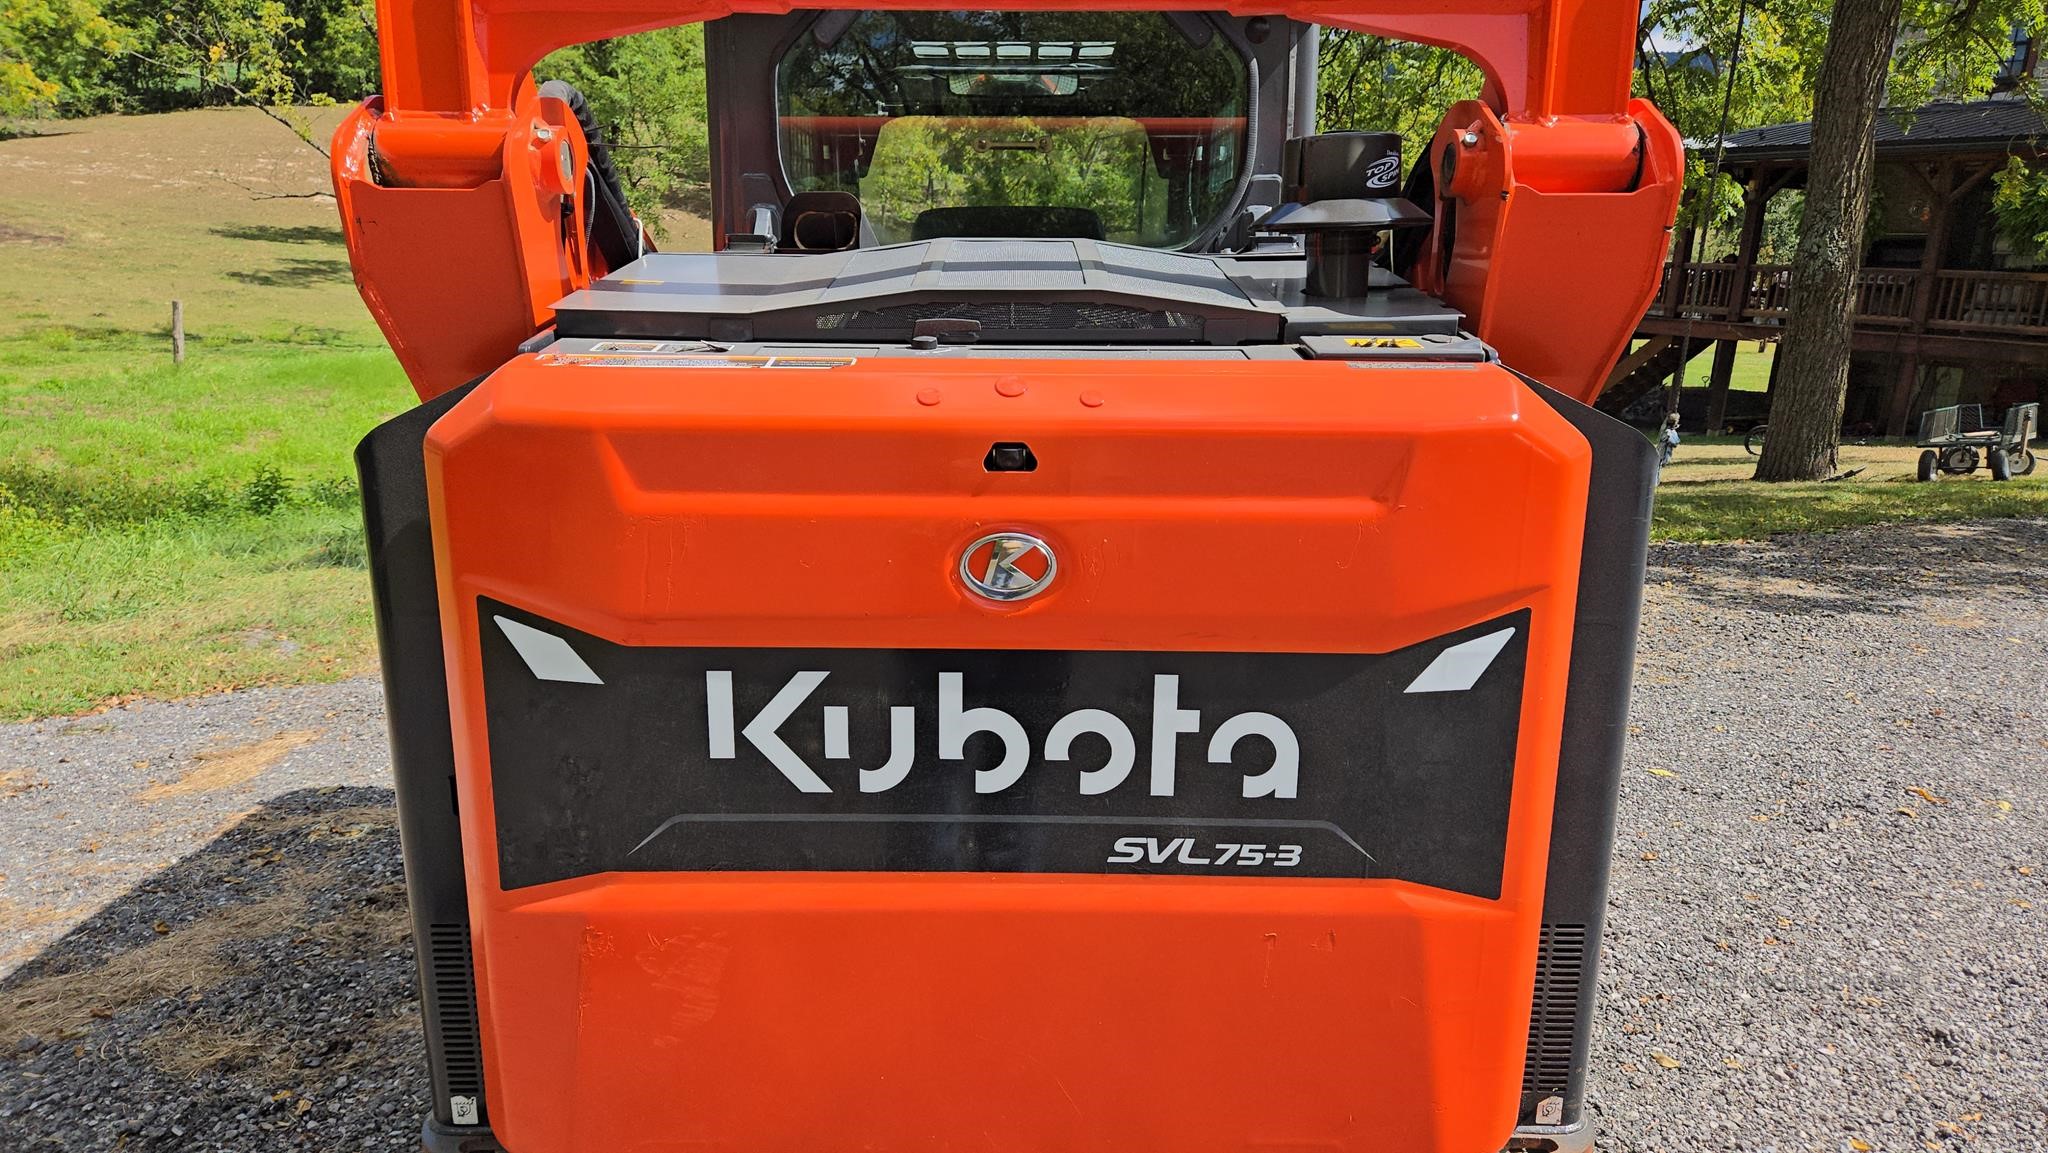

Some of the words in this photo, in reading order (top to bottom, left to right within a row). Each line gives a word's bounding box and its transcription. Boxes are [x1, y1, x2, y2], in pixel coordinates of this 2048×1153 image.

[1366, 163, 1391, 176] TOP
[979, 537, 1041, 592] K
[706, 671, 1300, 798] Kubota
